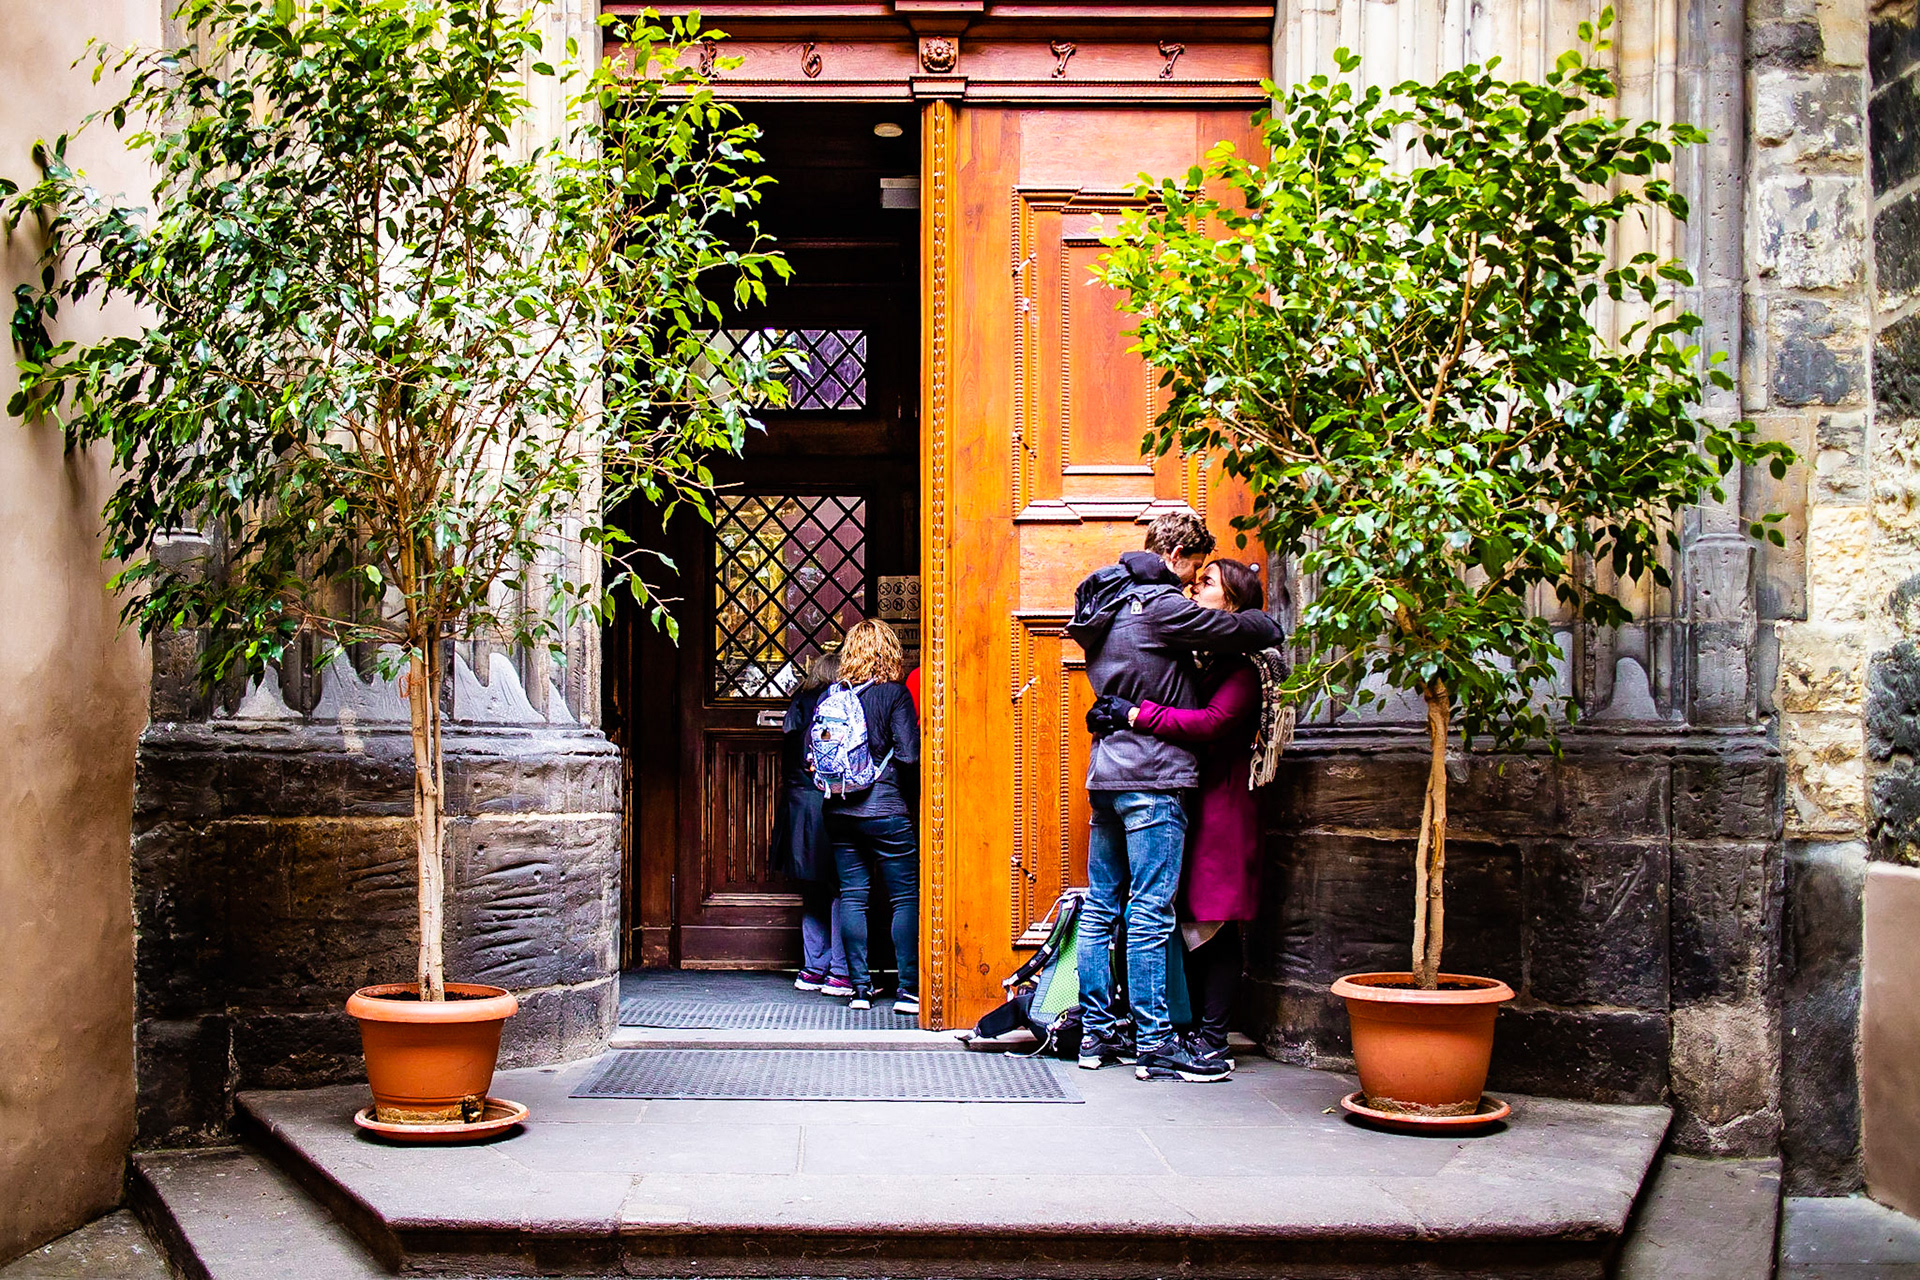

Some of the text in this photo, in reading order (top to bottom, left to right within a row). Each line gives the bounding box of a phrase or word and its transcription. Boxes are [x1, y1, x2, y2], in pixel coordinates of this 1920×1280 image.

[801, 42, 822, 78] 6
[1050, 40, 1077, 78] 7
[1158, 40, 1186, 79] 7
